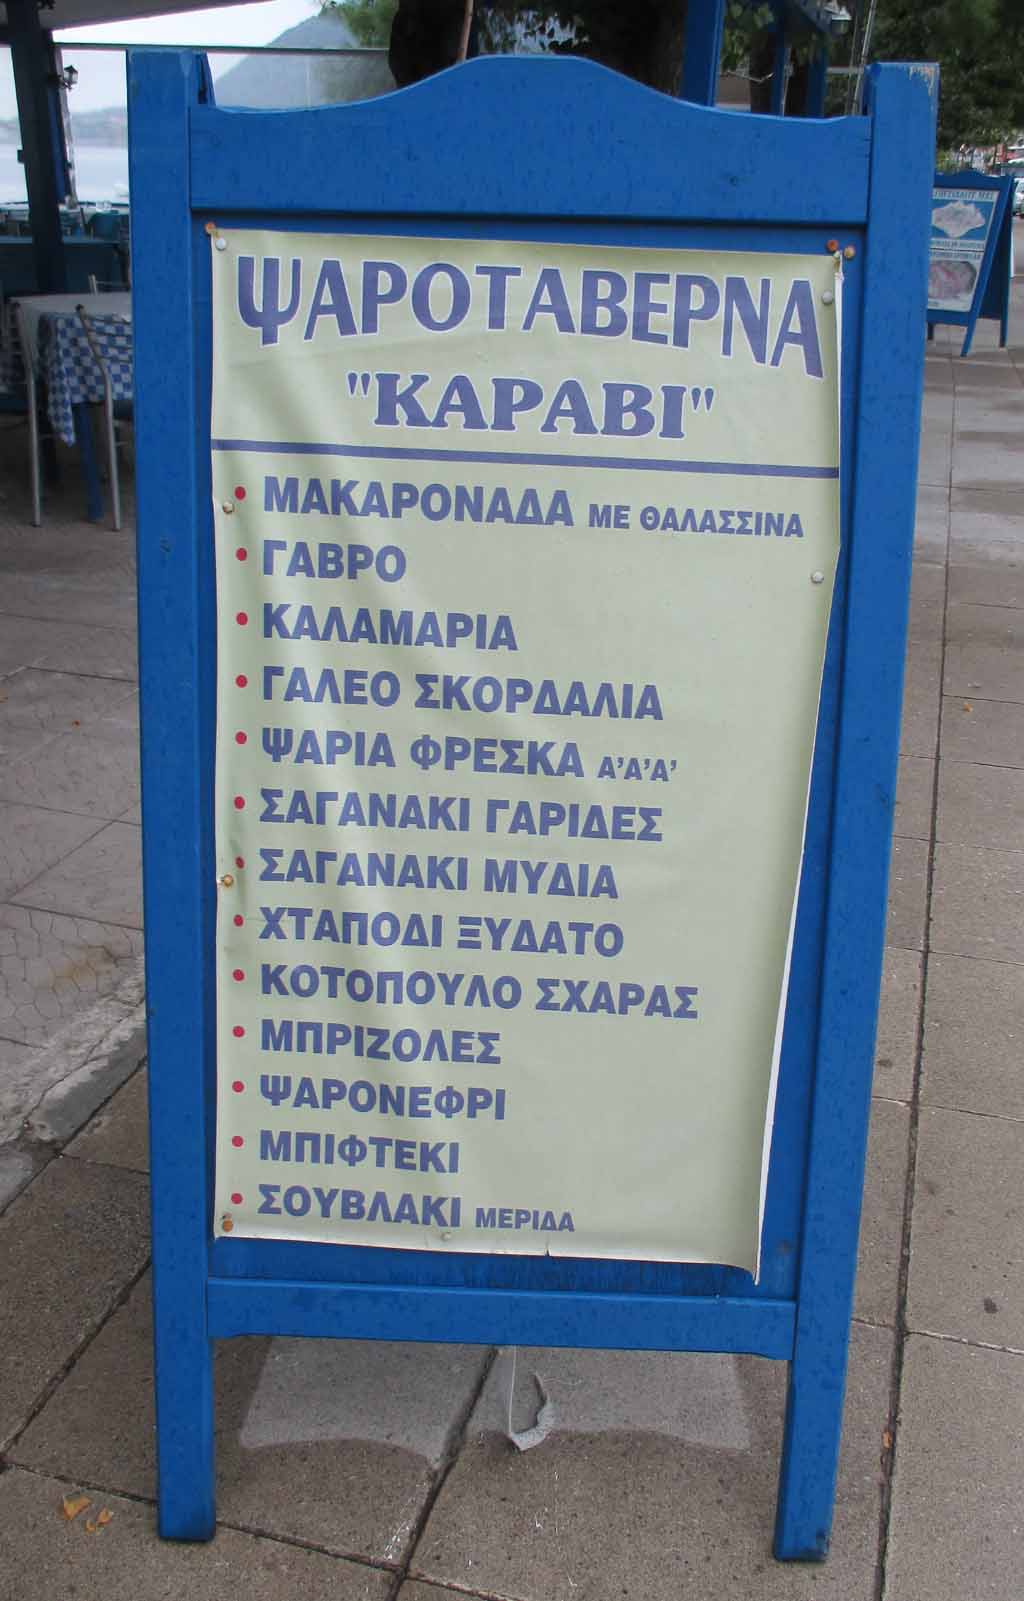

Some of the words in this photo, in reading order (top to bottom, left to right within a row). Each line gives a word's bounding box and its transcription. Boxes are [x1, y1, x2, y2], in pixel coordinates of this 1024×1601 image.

[238, 256, 823, 378] ΨΑΡΟΤΑΒΕΡΝΑ
[348, 373, 714, 438] "ΚΑΡΑΒΙ"
[264, 476, 573, 526] ΜΑΚΑΡΟΝΑΔΑ
[589, 505, 630, 528] ΜΕ
[640, 506, 803, 537] ΘΑΛΑΣΣΙΝΑ
[263, 540, 406, 582] ΓΑΒΡΟ
[264, 603, 518, 651] ΚΑΛΑΜΑΡΙΑ
[263, 666, 400, 707] ΓΑΛΕΟ
[416, 674, 662, 720] ΣΚΟΡΔΑΛΙΑ
[262, 728, 394, 767] ΨΑΡΙΑ
[410, 736, 584, 777] ΦΡΕΣΚΑ
[260, 789, 470, 832] ΣΑΓΑΝΑΚΙ
[487, 800, 662, 842] ΓΑΡΙΔΕΣ
[260, 848, 468, 891] ΣΑΓΑΝΑΚΙ
[484, 859, 618, 897] ΜΥΔΙΑ
[260, 907, 442, 947] ΧΤΑΠΟΔΙ
[457, 916, 623, 957] ΞΥΔΑΤΟ
[261, 964, 522, 1008] ΚΟΤΟΠΟΥΛΟ
[536, 979, 698, 1019] ΣΧΑΡΑΣ
[261, 1019, 500, 1064] ΜΠΡΙΖΟΛΕΣ
[260, 1074, 505, 1120] ΨΑΡΟΝΕΦΡΙ
[260, 1130, 459, 1173] ΜΠΙΦΤΕΚΙ
[258, 1184, 460, 1228] ΣΟΥΒΛΑΚΙ
[476, 1208, 574, 1232] ΜΕΡΙΔΑ
